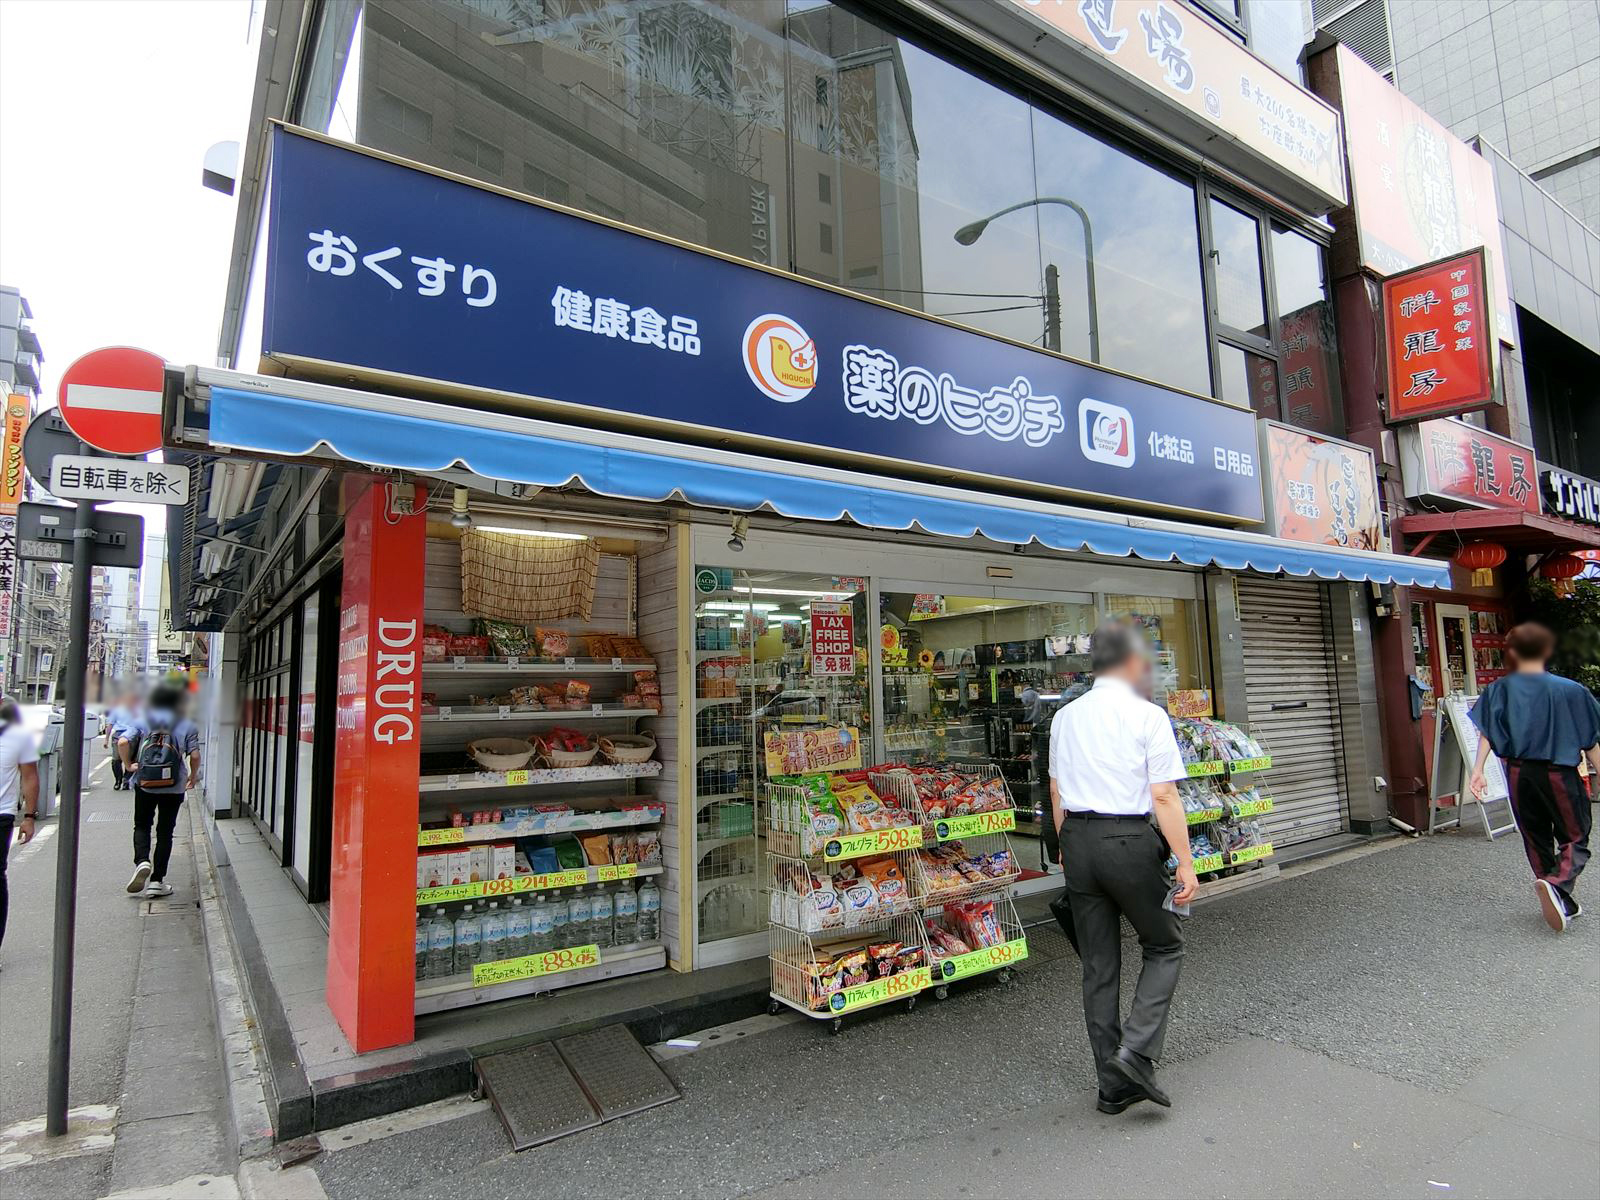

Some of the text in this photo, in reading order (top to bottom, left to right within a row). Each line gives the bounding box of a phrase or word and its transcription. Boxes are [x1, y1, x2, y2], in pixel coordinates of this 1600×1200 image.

[306, 229, 498, 308] おくすり
[551, 285, 701, 356] 健康食品
[845, 346, 1064, 447] 薬のヒグチ
[1147, 431, 1195, 465] 化粧品
[1213, 447, 1254, 477] 日用品
[60, 465, 182, 495] 自転車を除く
[820, 616, 844, 628] TAX
[816, 629, 849, 640] FREE
[815, 642, 850, 653] SHOP
[825, 656, 852, 672] 免税
[373, 617, 416, 744] DRUG
[980, 813, 1000, 832] 78
[843, 837, 873, 853] フルグラ
[878, 828, 909, 851] 598
[482, 878, 514, 896] 198
[521, 875, 548, 890] 214
[543, 949, 573, 972] 88
[887, 974, 909, 996] 88
